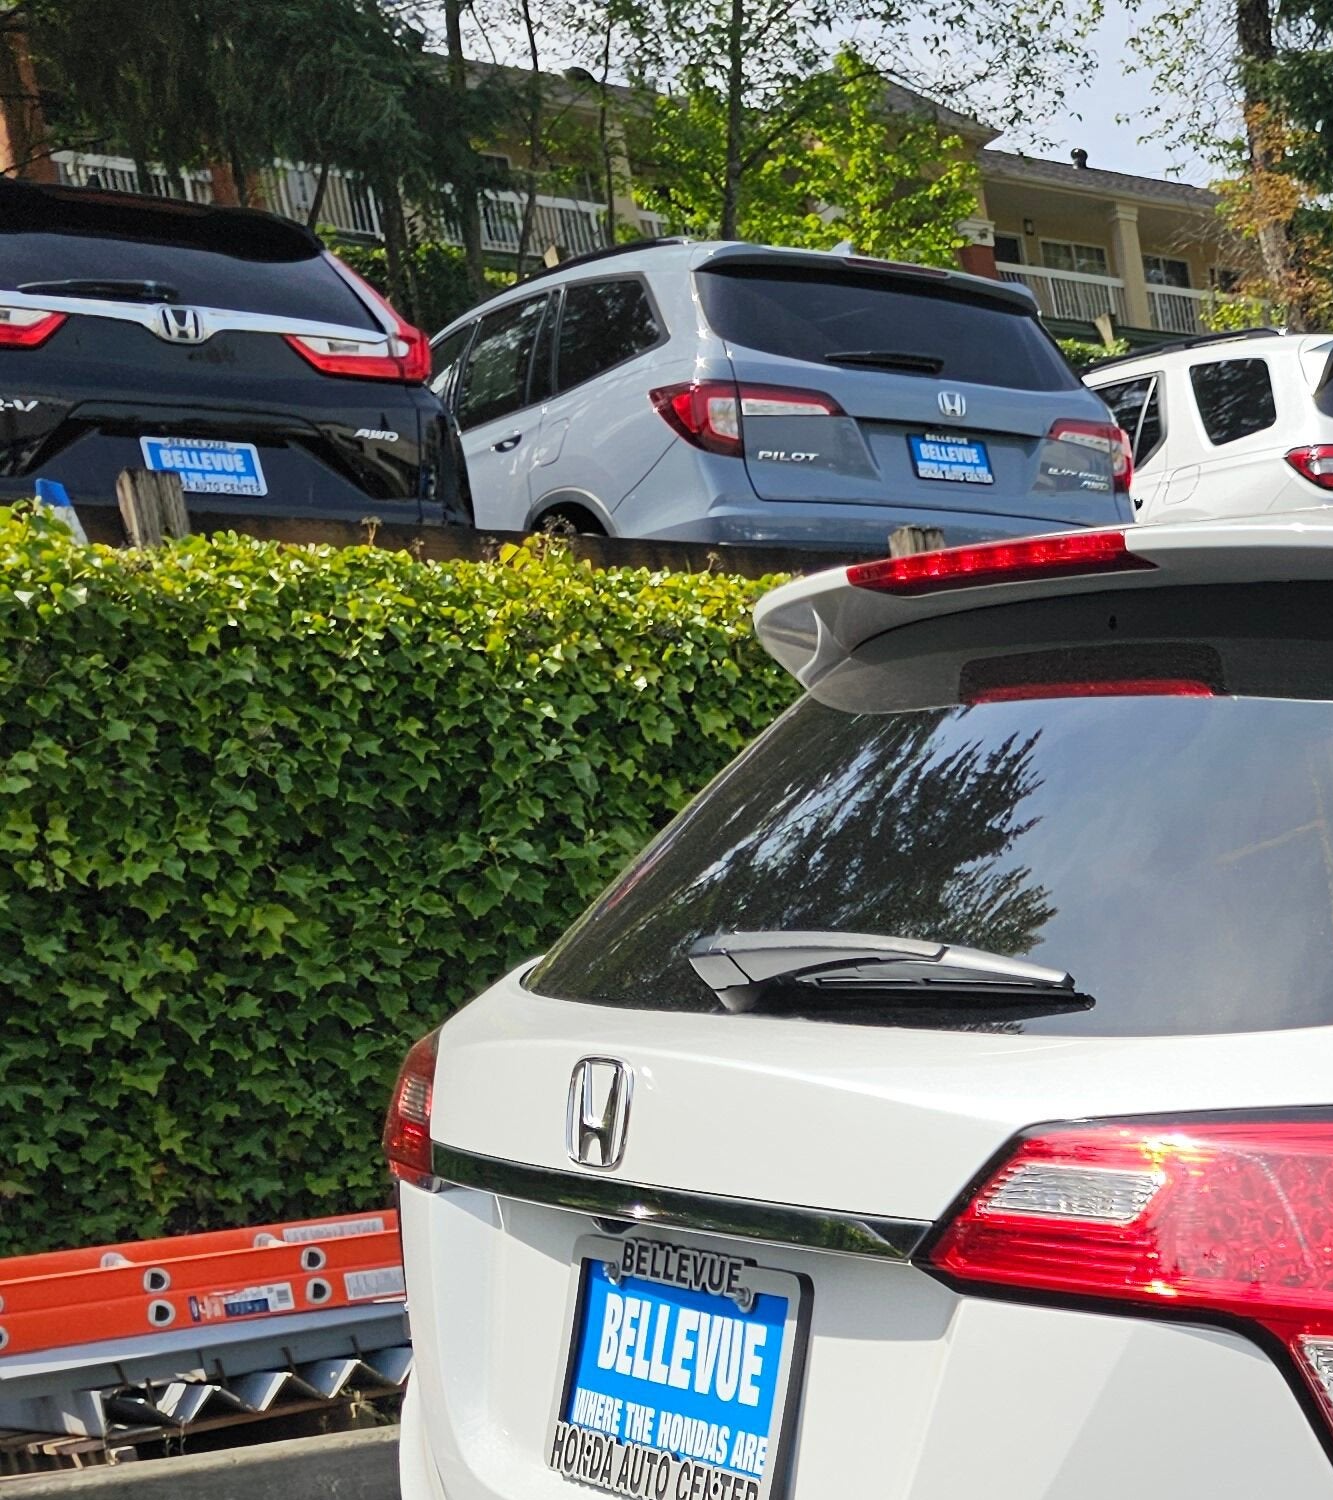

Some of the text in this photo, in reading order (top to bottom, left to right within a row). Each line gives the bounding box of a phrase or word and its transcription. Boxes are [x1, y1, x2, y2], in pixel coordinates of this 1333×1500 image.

[159, 449, 246, 472] BELLEVUE
[758, 450, 819, 461] PILOT
[920, 443, 980, 464] BELLEVUE
[195, 482, 220, 492] AUTO
[223, 483, 262, 495] CENTER
[621, 1238, 745, 1296] BELLEVUE
[597, 1292, 768, 1407] BELLEVUE
[572, 1387, 769, 1476] WHERE THE HONDAS ARE
[550, 1424, 615, 1488] HONDA
